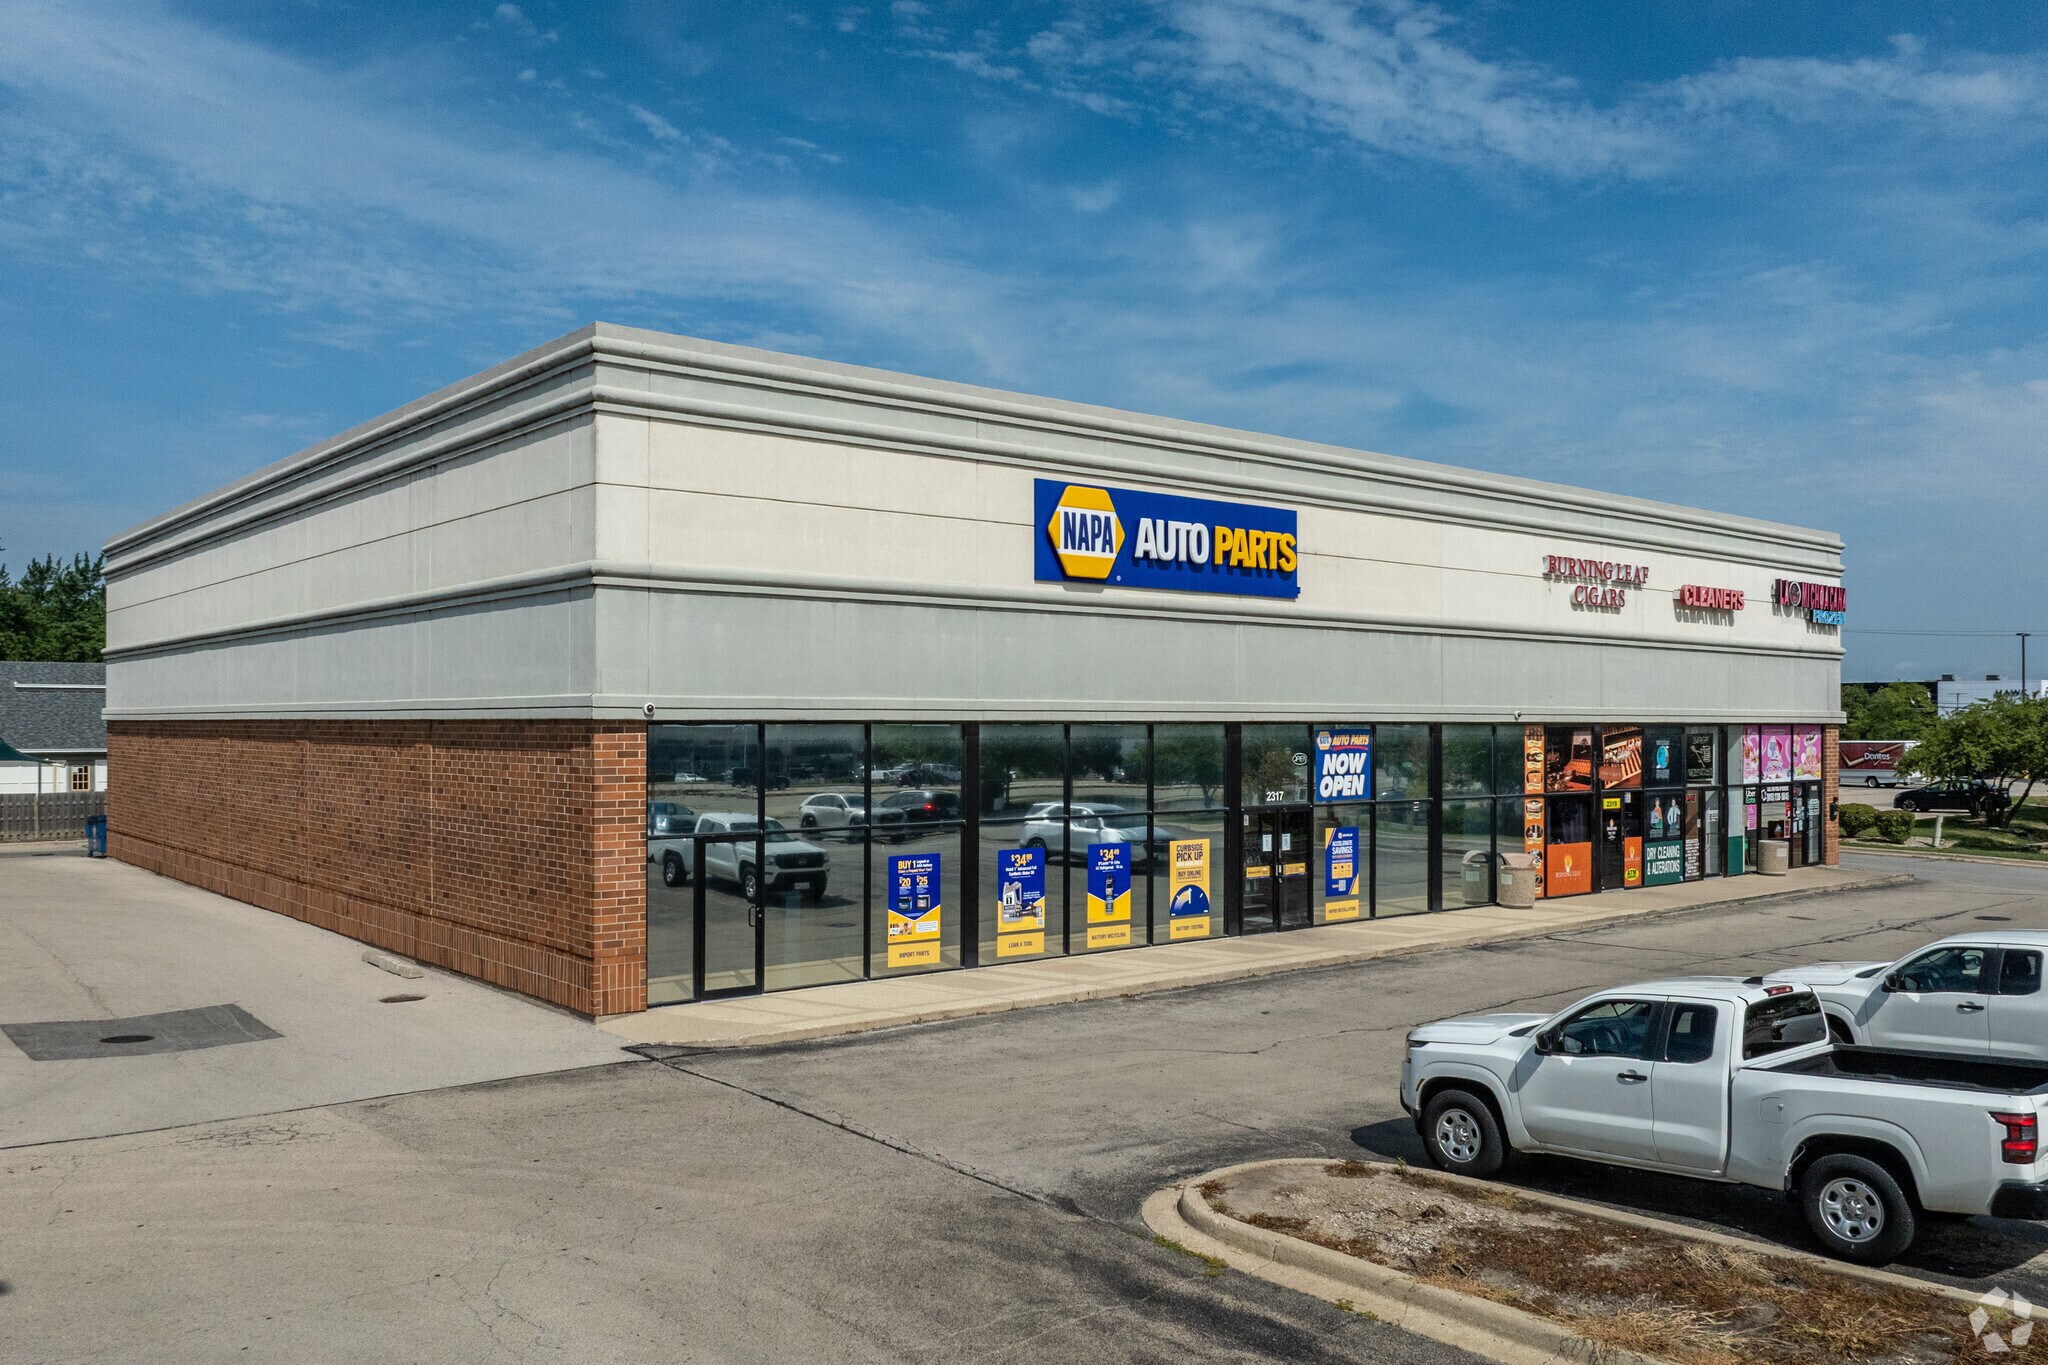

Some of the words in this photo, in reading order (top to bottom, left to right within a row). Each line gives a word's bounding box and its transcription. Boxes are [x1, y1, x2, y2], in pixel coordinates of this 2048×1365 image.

[1063, 511, 1114, 554] NAPA
[1134, 517, 1209, 564] AUTO
[1214, 525, 1297, 572] PARTS
[1547, 555, 1613, 580] BURNING
[1616, 563, 1649, 584] LEAF
[1574, 585, 1626, 608] CIGARS
[1683, 584, 1745, 611] CLEANERS
[1779, 578, 1790, 605] LA
[1812, 609, 1846, 625] FROZEN
[1332, 735, 1349, 746] AUTO
[1350, 734, 1369, 746] PARTS
[1322, 752, 1367, 775] NOW
[1864, 752, 1890, 760] Doritos
[1319, 775, 1365, 798] OPEN
[1266, 791, 1284, 802] 2317
[1176, 843, 1203, 852] CURBSIDE
[1332, 846, 1353, 855] SAVINGS
[1646, 847, 1656, 860] DRY
[1657, 845, 1680, 859] CLEANING
[1176, 852, 1192, 862] PICK
[1194, 851, 1203, 860] UP
[897, 860, 911, 870] BUY
[912, 860, 916, 869] 1
[1646, 862, 1651, 875] &
[1651, 860, 1680, 875] ALTERATIONS
[1187, 869, 1201, 877] ONLINE
